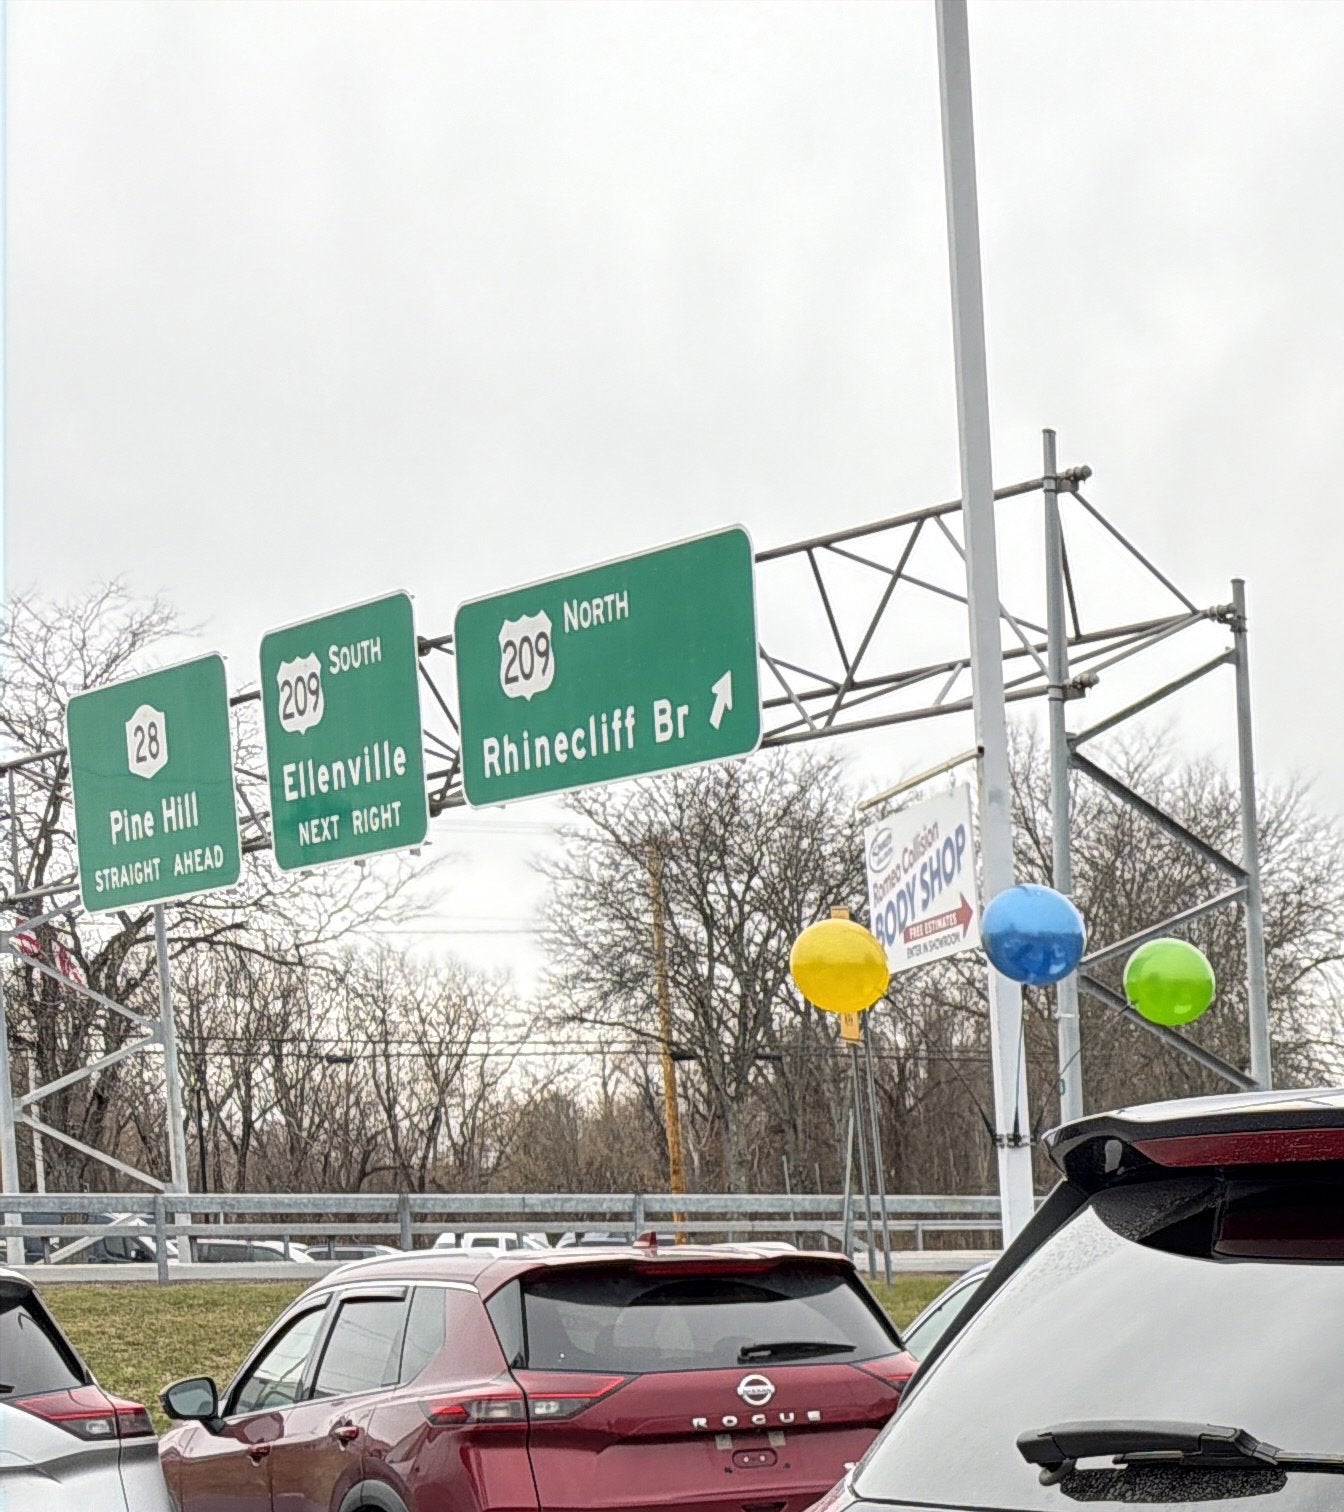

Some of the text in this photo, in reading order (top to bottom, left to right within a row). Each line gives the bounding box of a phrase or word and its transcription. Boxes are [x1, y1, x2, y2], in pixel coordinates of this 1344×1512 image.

[564, 590, 629, 633] NORTH
[328, 637, 382, 674] SOUTH
[503, 631, 550, 685] 209
[281, 671, 320, 720] 209
[134, 721, 160, 764] 28
[483, 699, 689, 778] Rhinecliff Br
[283, 740, 406, 801] Ellenville
[110, 791, 198, 845] Pine Hill
[299, 801, 401, 846] NEXT RIGHT
[95, 845, 224, 892] STRAIGHT AHEAD
[872, 863, 901, 908] Romeo
[902, 821, 939, 875] Collision
[875, 873, 916, 947] BODY
[920, 823, 966, 911] SHOP
[909, 923, 924, 939] FREE
[692, 1410, 821, 1429] ROGUE
